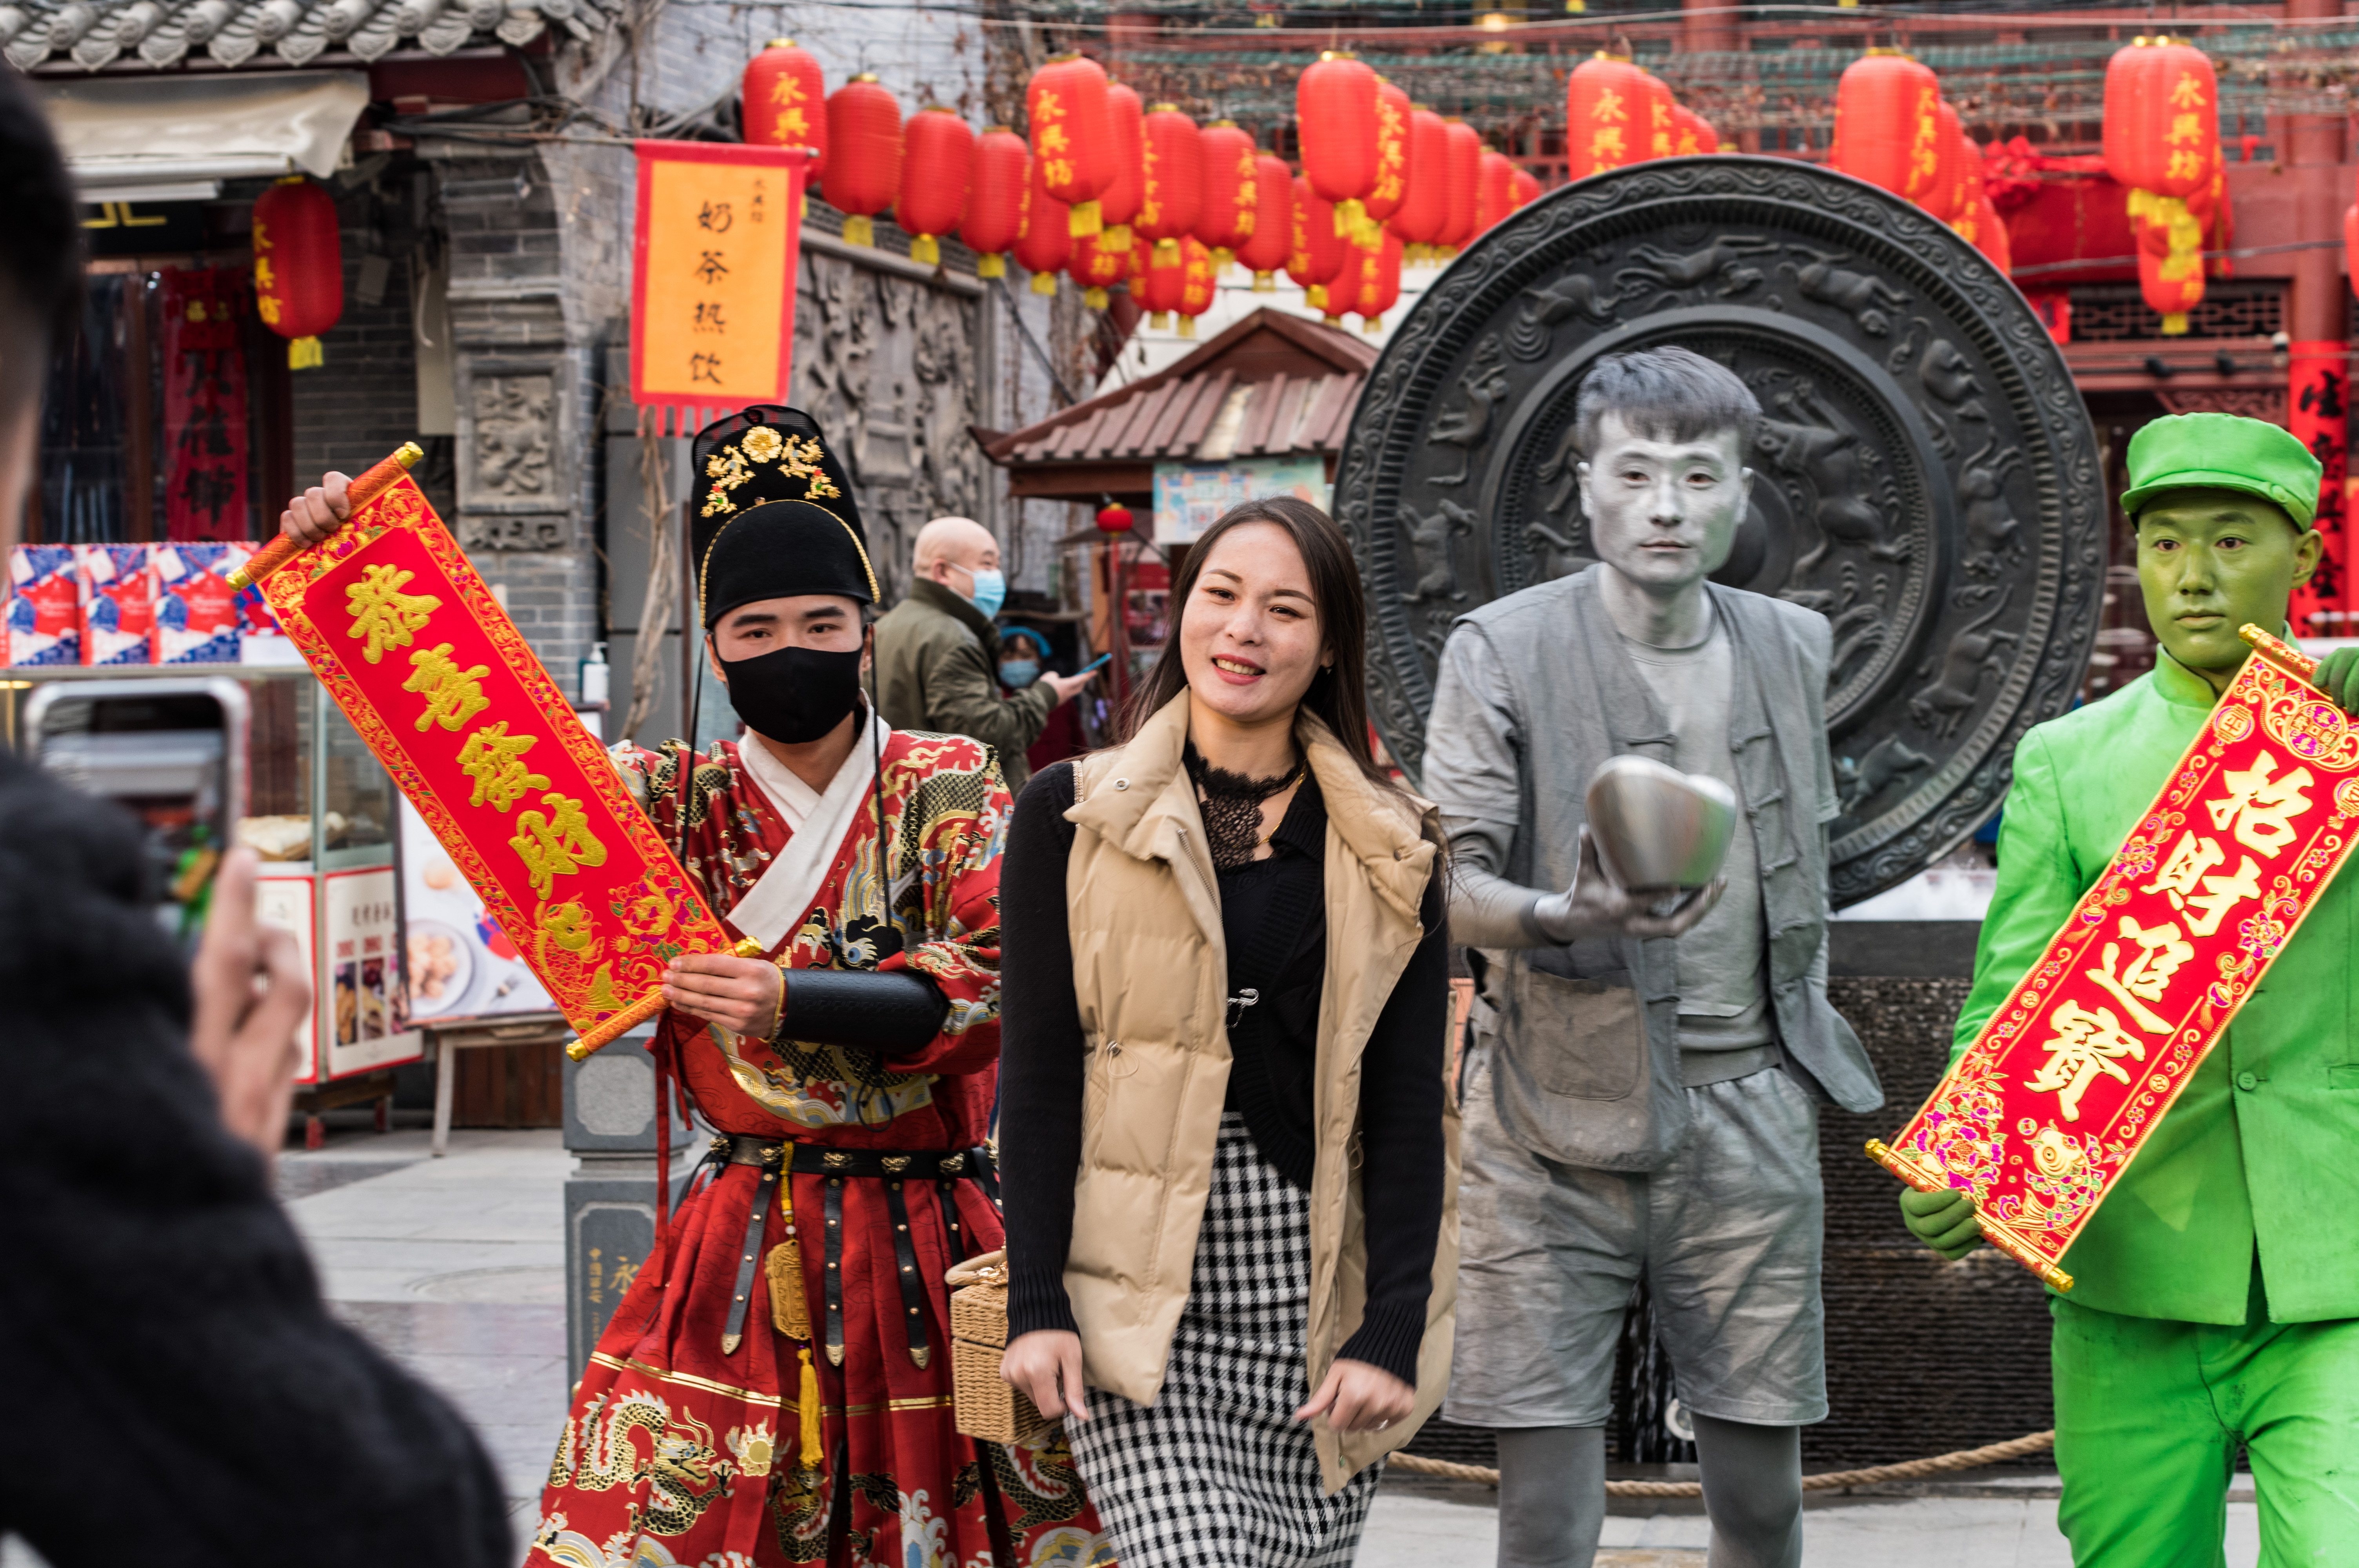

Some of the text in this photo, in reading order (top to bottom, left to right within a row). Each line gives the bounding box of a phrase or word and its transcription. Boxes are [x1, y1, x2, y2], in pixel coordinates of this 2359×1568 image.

[1034, 89, 1075, 187] 永興坊
[2163, 73, 2207, 181] 永興坊
[689, 200, 733, 385] 奶茶热饮
[345, 563, 608, 901] 恭喜發財
[2023, 750, 2315, 1122] 招財進寶
